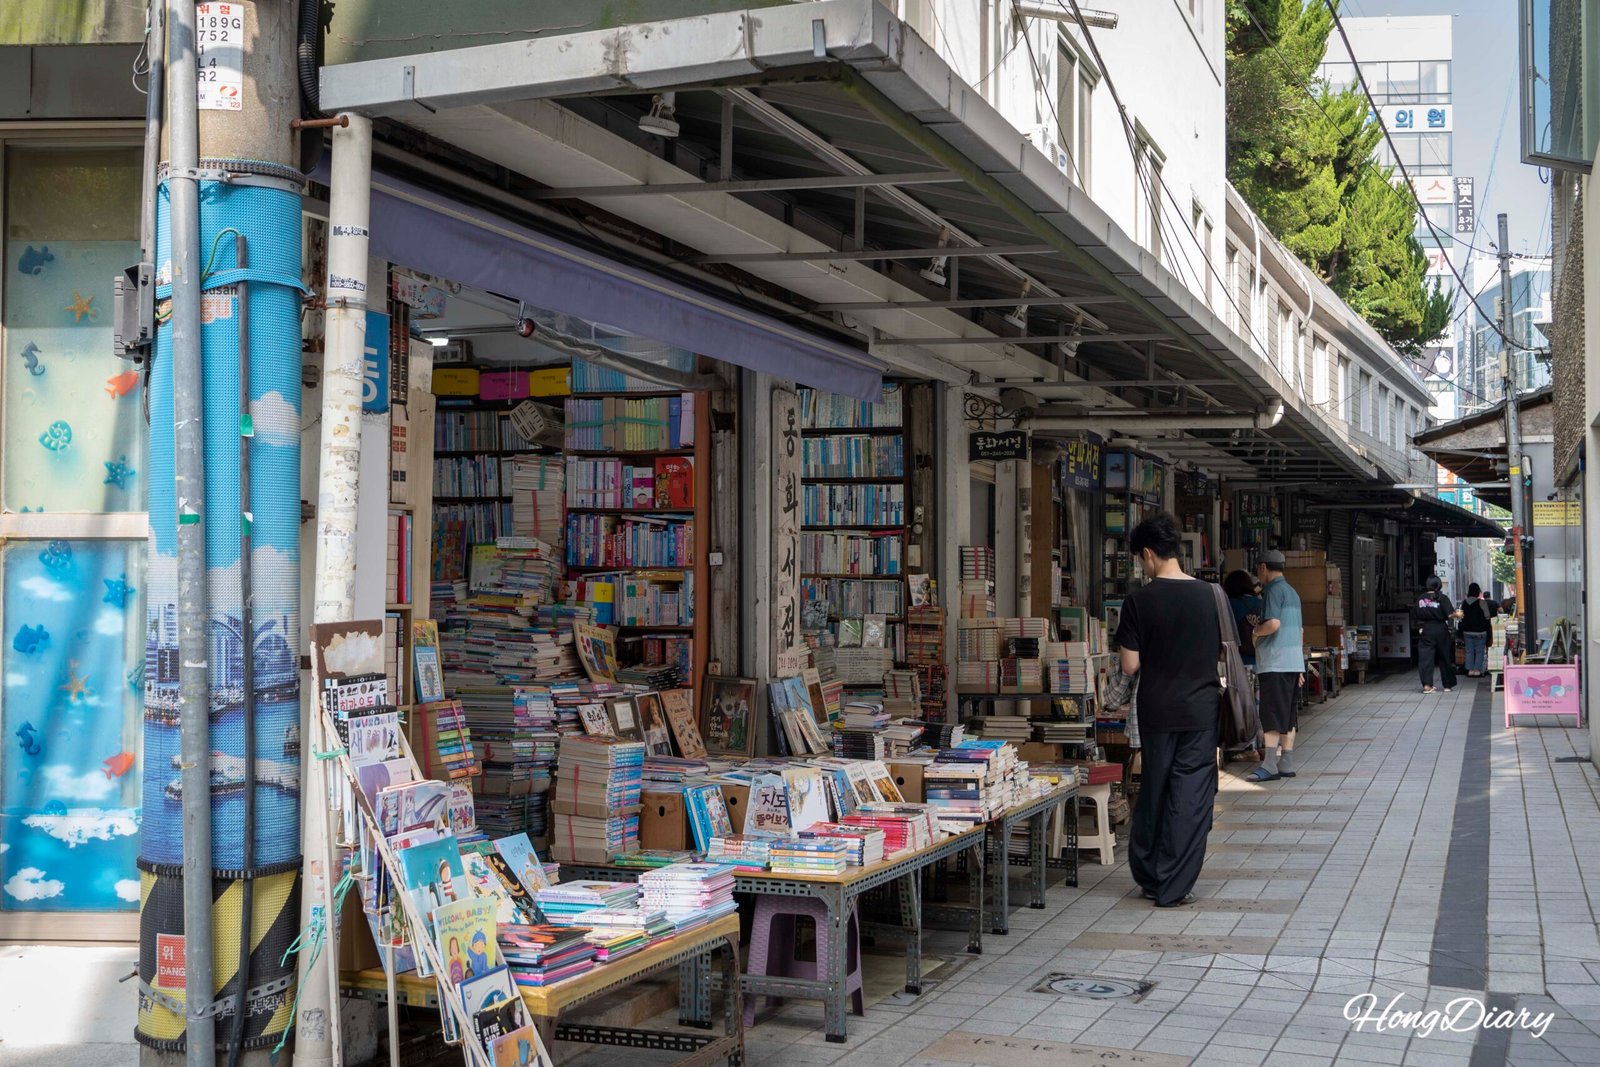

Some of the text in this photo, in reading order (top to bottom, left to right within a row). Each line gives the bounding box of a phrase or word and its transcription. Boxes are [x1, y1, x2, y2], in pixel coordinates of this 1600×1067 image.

[199, 4, 231, 15] 위험
[199, 17, 241, 29] 189G
[199, 30, 229, 42] 752
[1364, 108, 1446, 129] 의원
